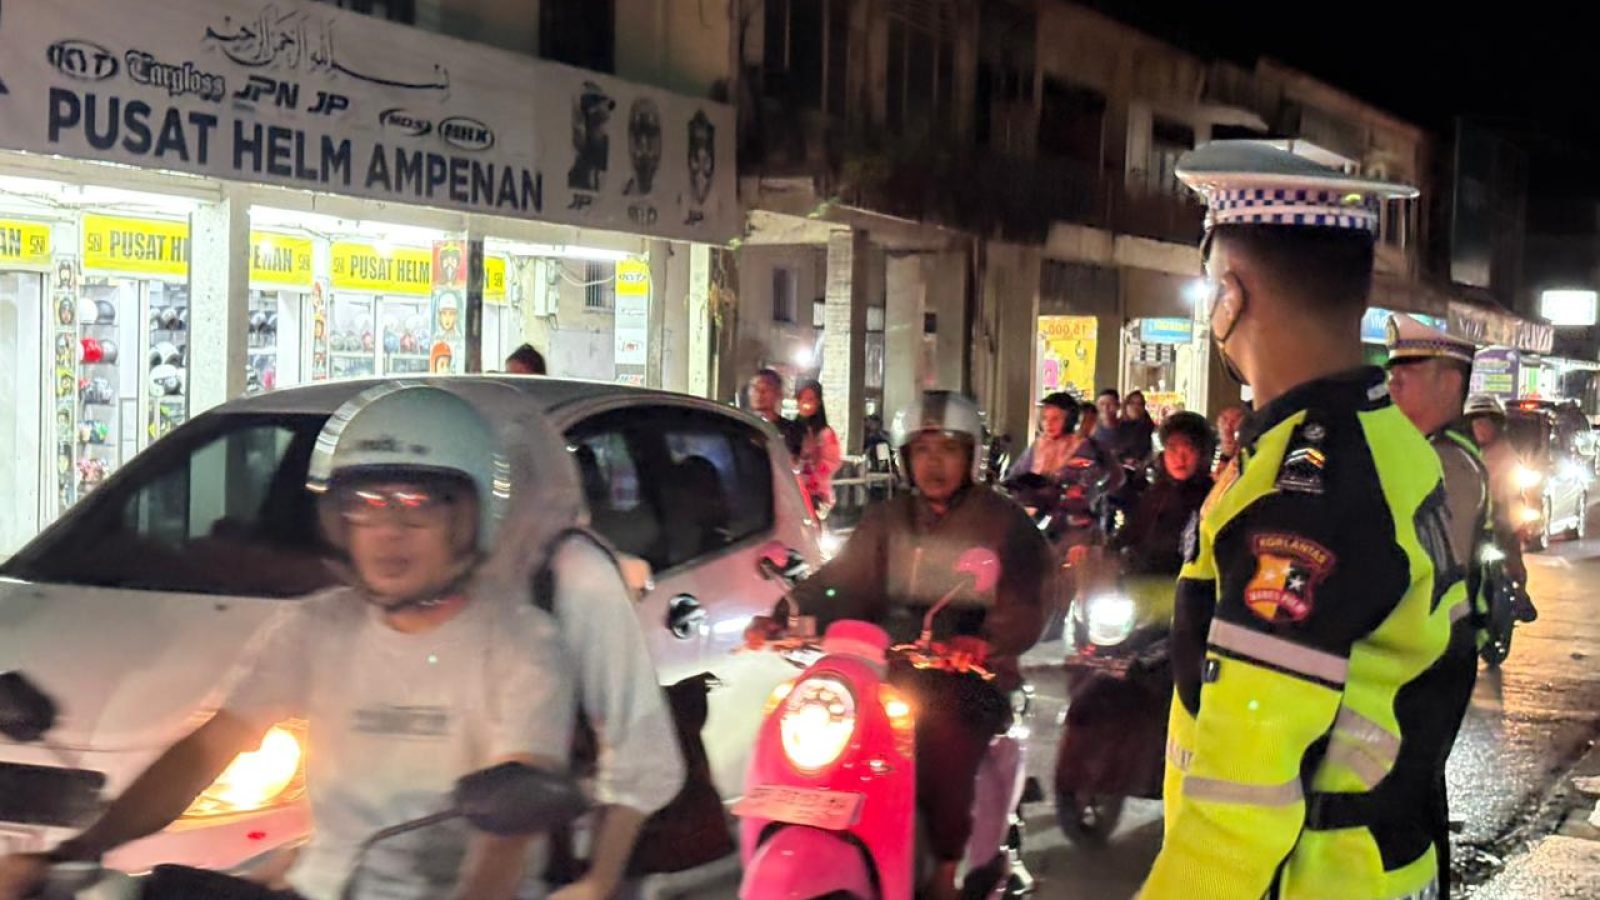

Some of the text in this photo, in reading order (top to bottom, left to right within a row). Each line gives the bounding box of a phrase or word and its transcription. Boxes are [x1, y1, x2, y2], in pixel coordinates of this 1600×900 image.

[233, 75, 300, 110] JPN
[307, 90, 349, 116] JP
[48, 86, 543, 213] PUSAT HELM AMPENAN
[109, 229, 167, 261] PUSAT
[350, 254, 430, 286] PUSAT HELM
[1258, 536, 1328, 565] KORLANTAS
